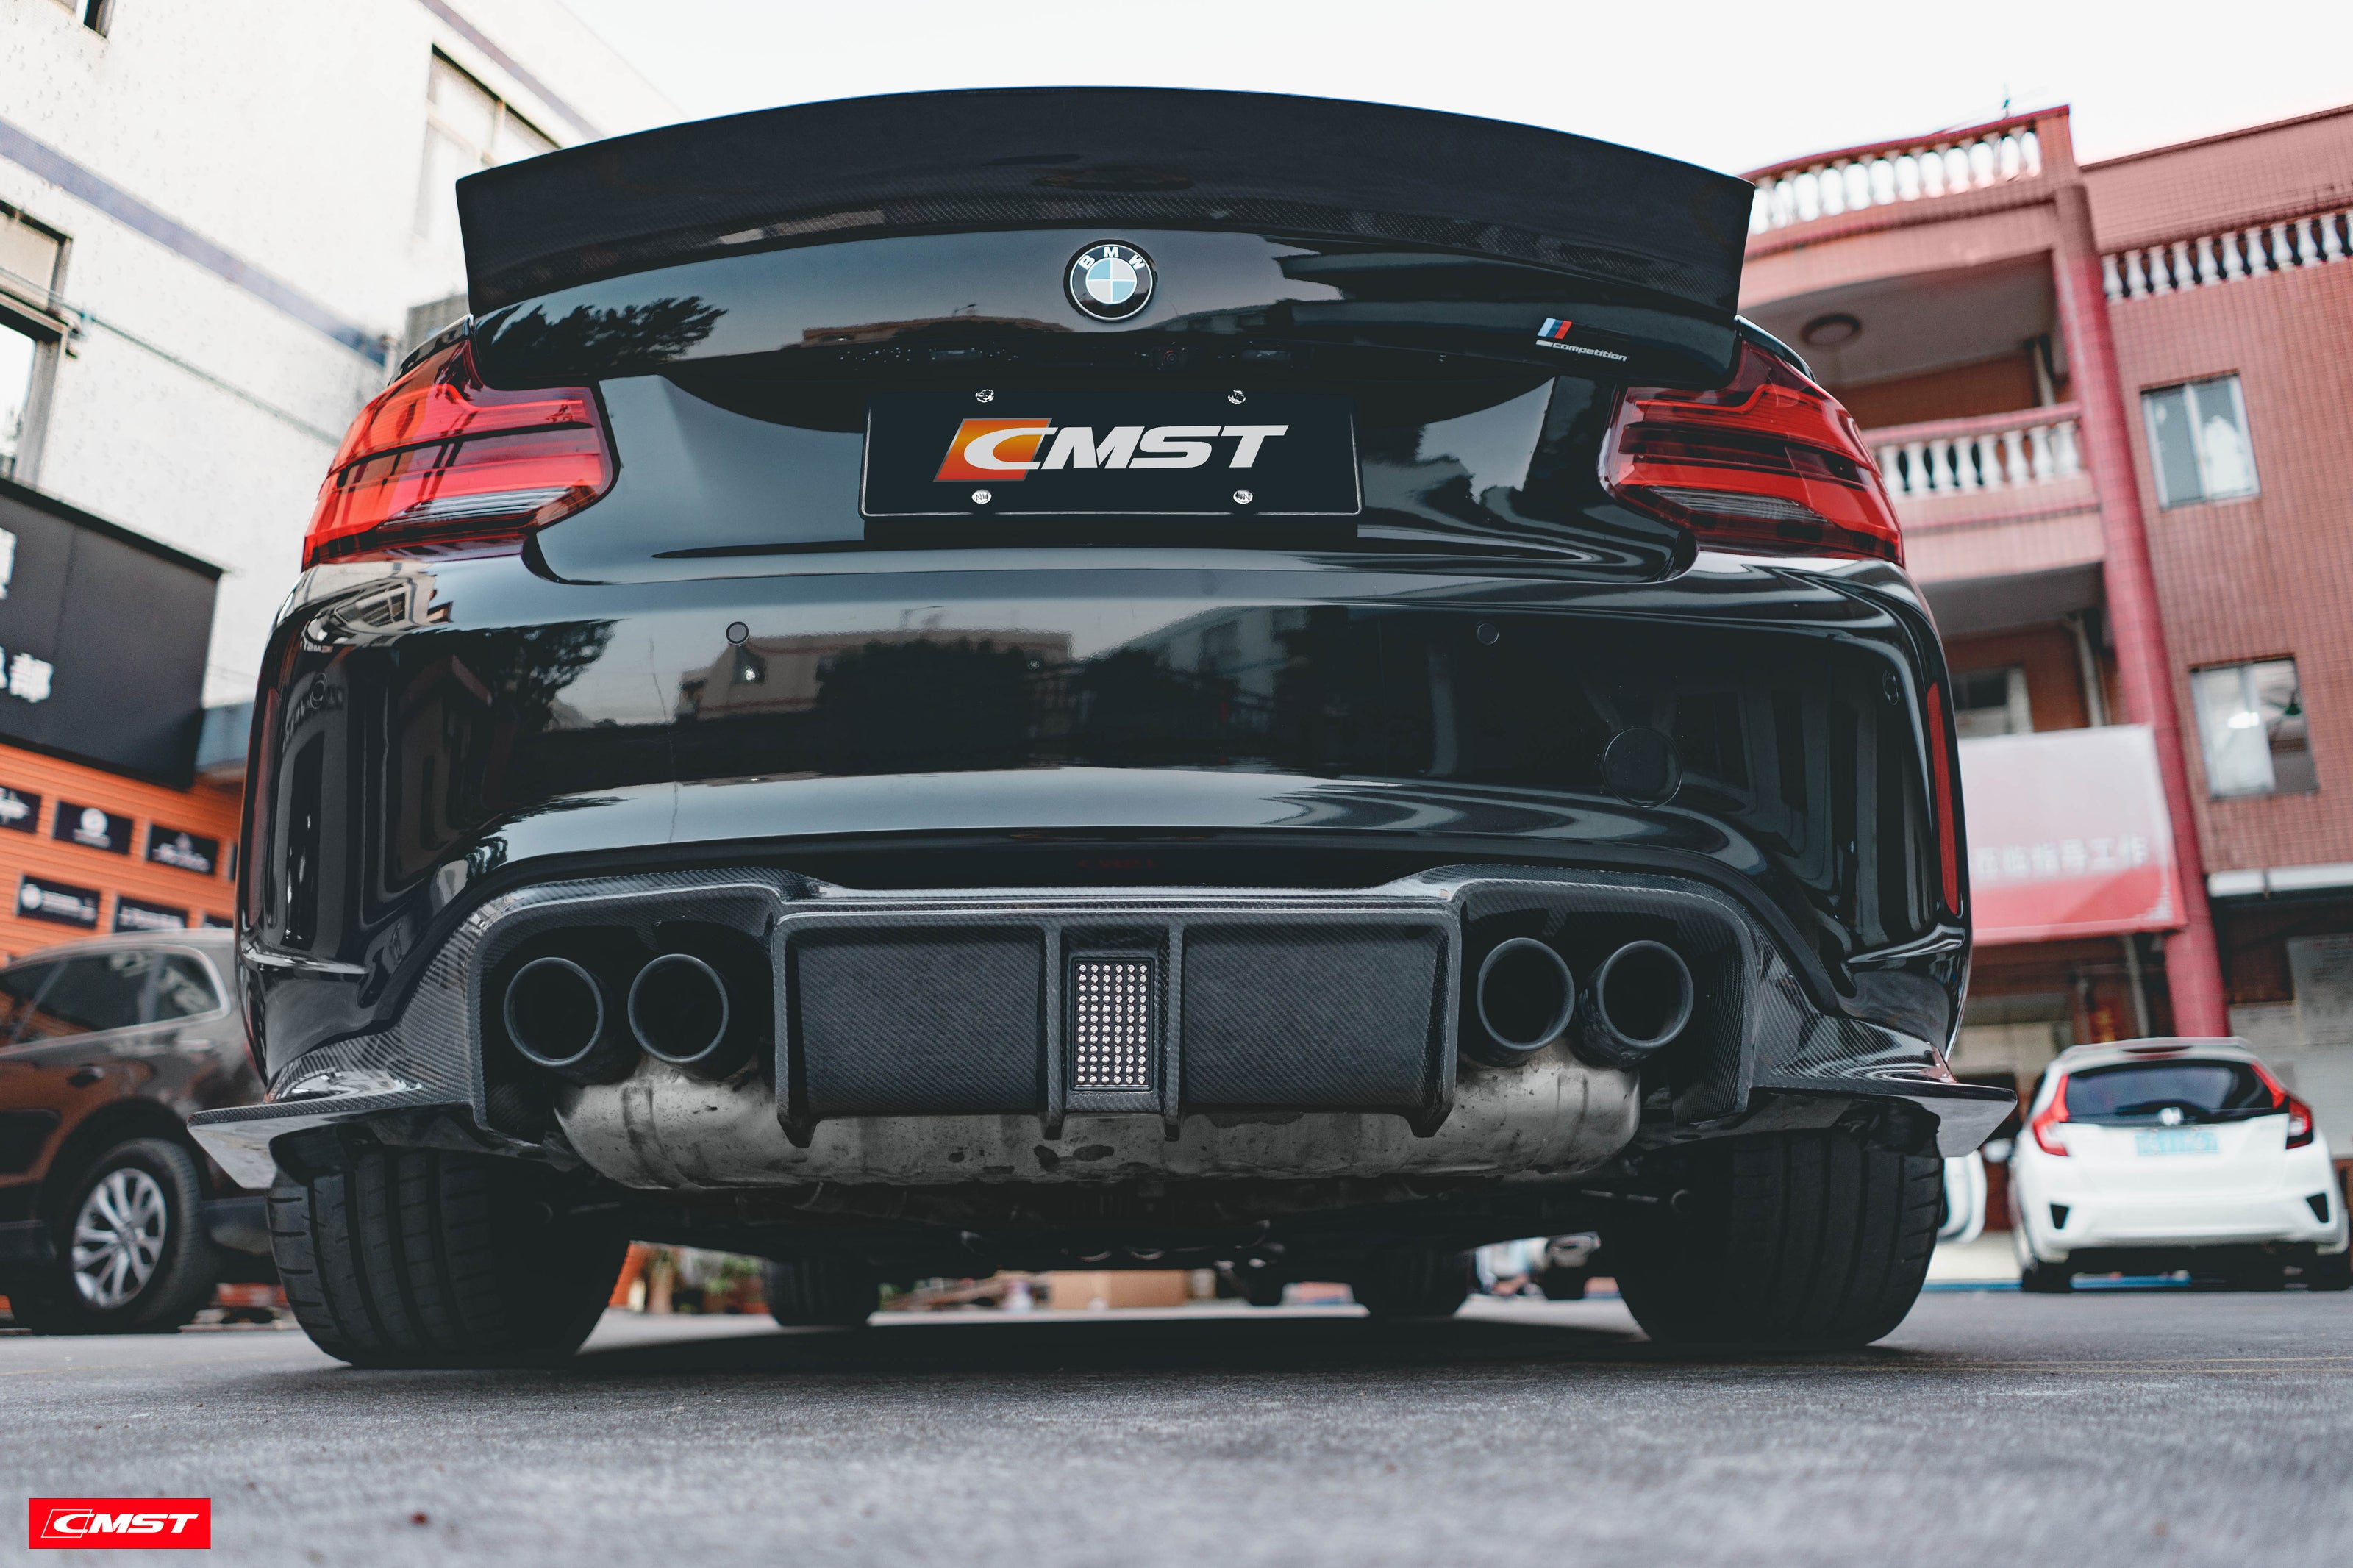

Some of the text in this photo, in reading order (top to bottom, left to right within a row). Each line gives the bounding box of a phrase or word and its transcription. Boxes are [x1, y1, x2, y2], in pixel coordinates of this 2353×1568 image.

[1078, 246, 1145, 270] BMW
[1552, 342, 1627, 362] competition
[964, 425, 1289, 469] CMST
